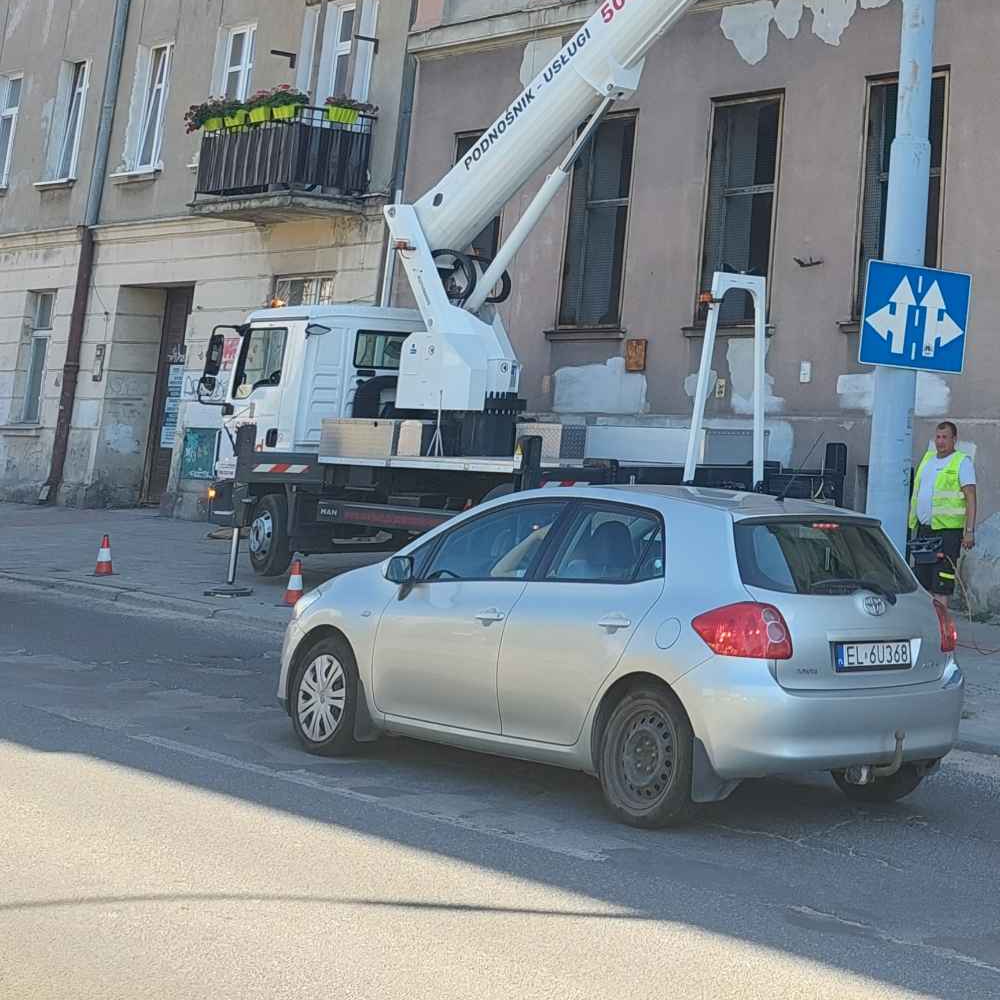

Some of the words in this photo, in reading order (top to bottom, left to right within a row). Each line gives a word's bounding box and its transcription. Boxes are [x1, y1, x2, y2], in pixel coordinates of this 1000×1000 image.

[543, 27, 591, 82] USŁUGI
[320, 508, 338, 516] MAN
[847, 646, 864, 665] EL
[869, 644, 908, 664] 6U368
